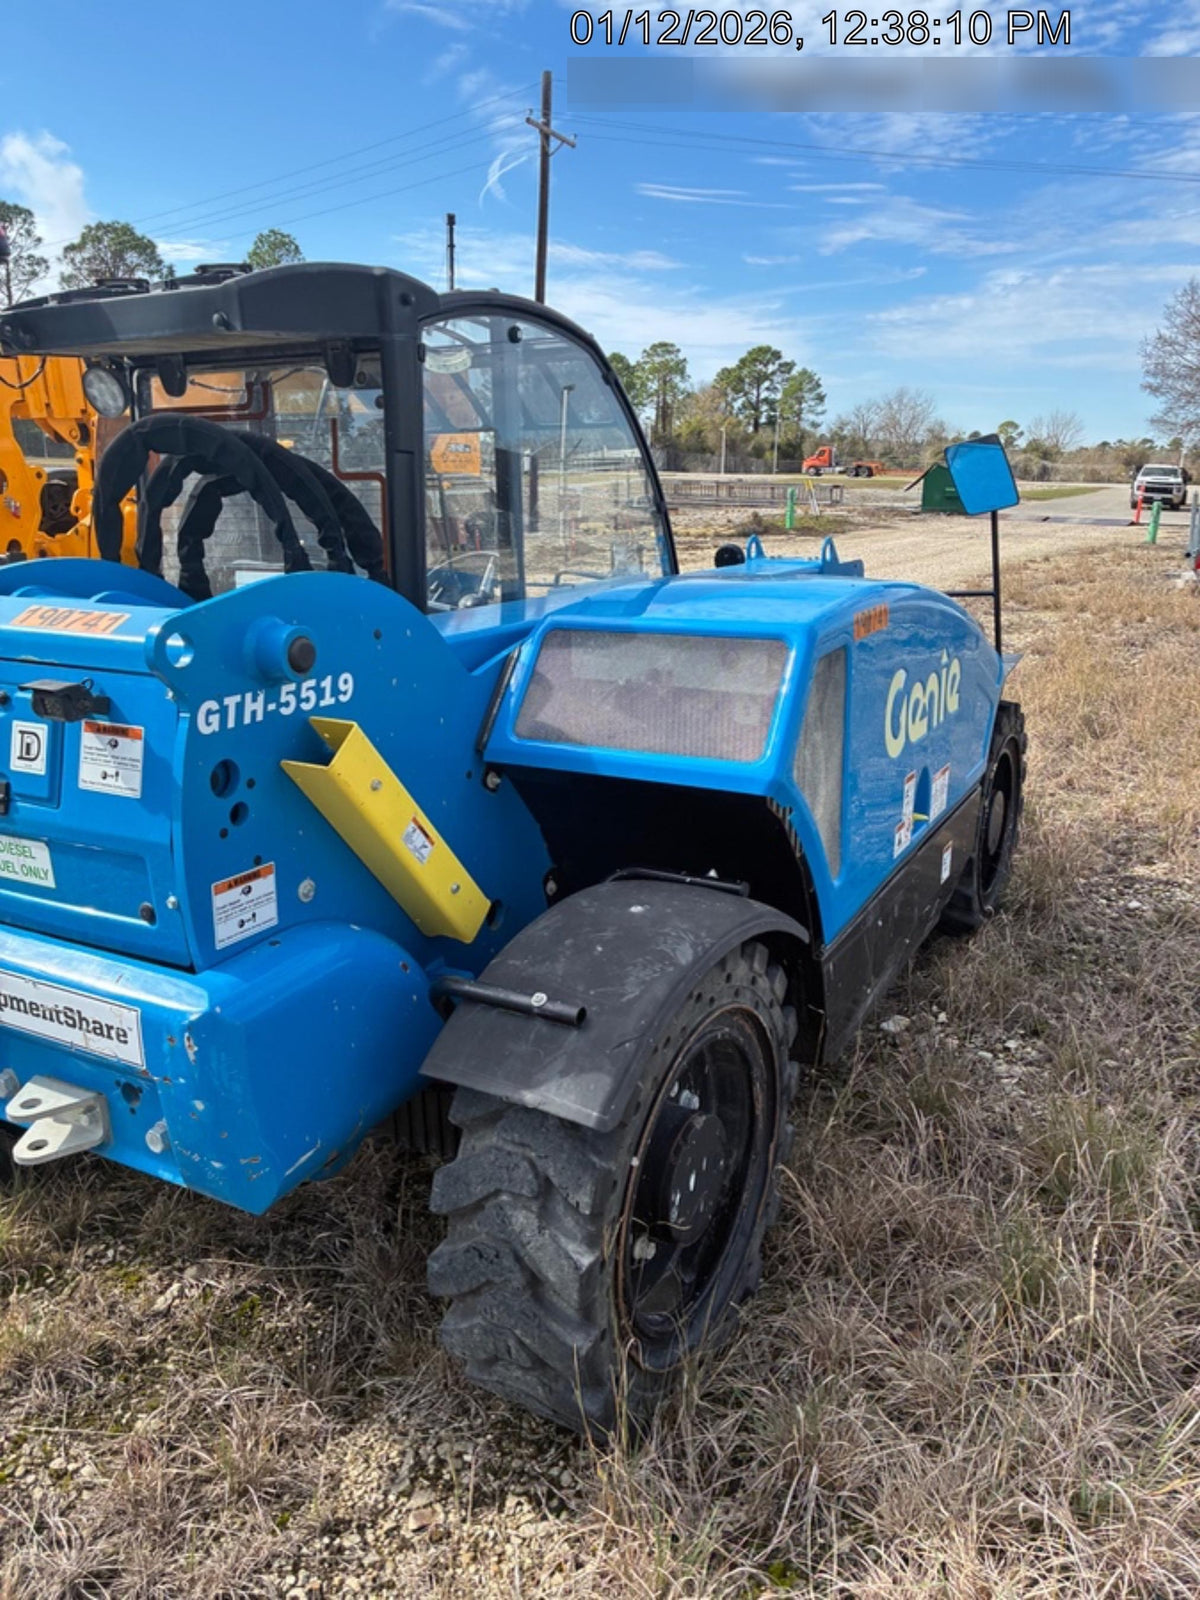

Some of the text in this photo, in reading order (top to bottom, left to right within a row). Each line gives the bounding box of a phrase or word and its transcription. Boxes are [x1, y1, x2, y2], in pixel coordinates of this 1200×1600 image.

[196, 671, 354, 735] GTH-5519
[885, 648, 961, 758] Genie
[20, 863, 49, 881] ONLY
